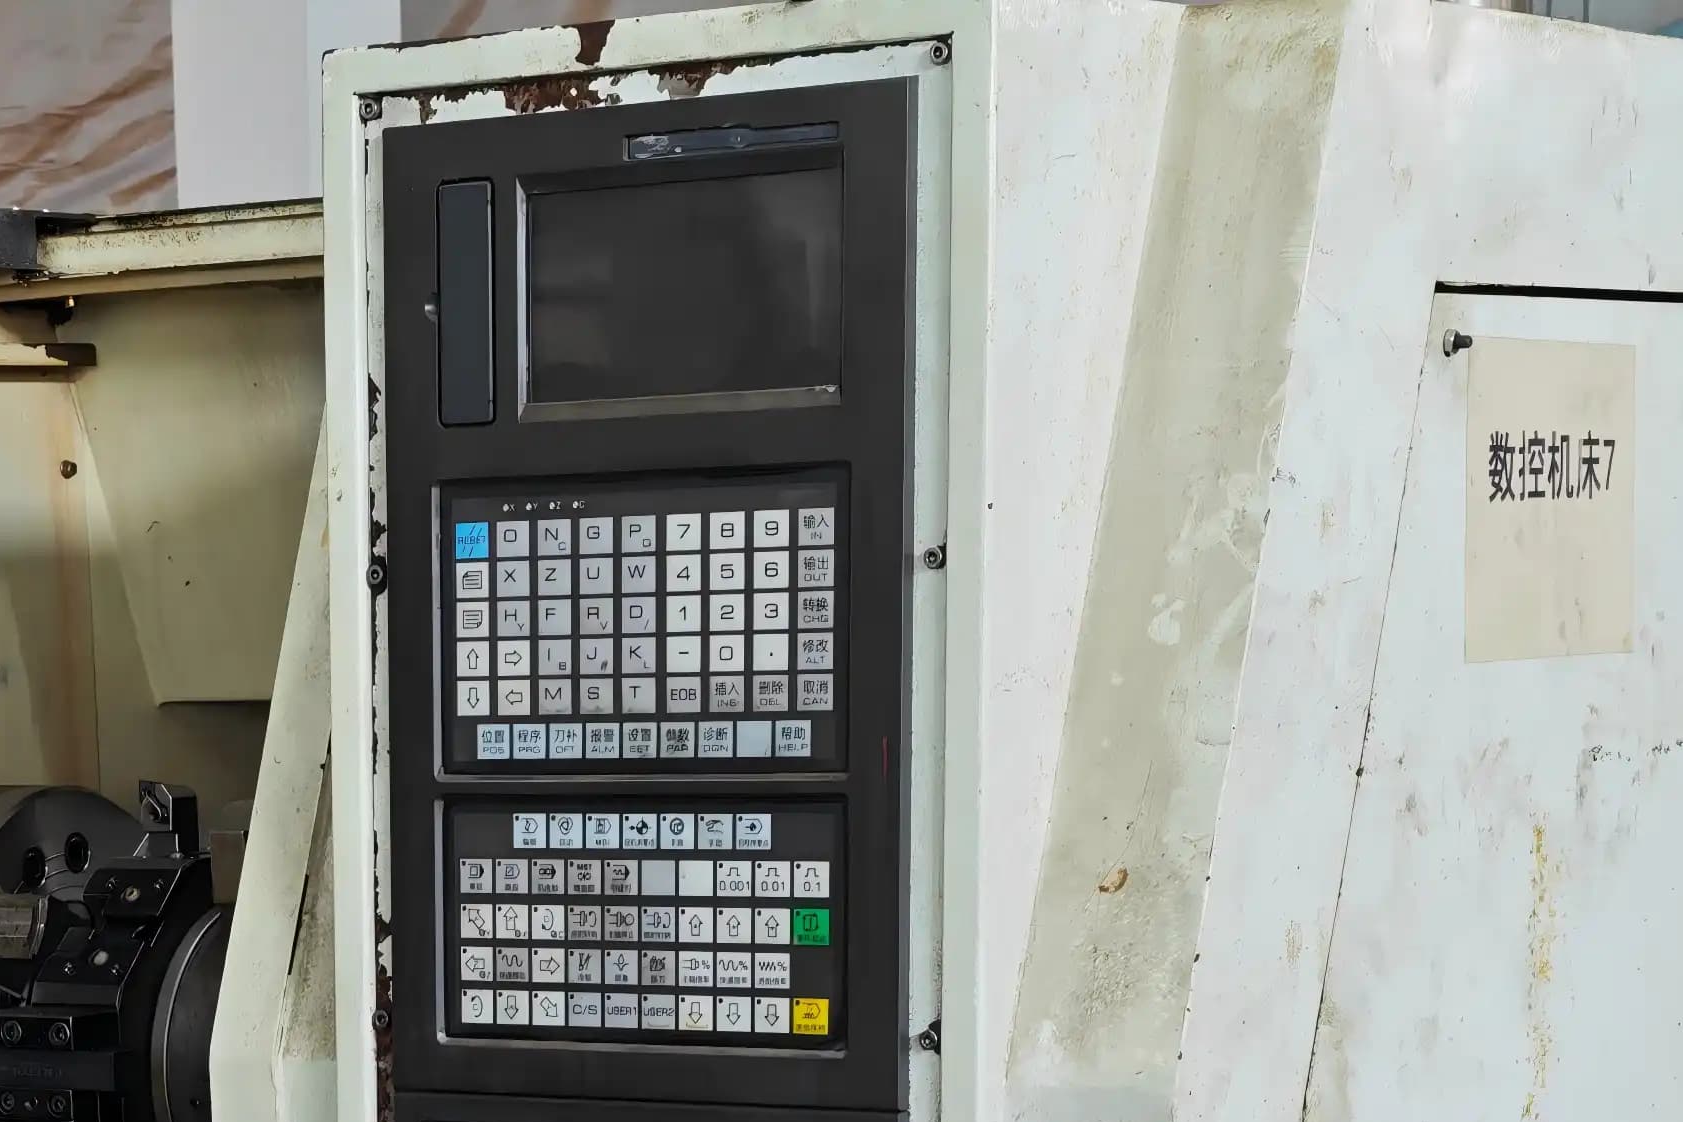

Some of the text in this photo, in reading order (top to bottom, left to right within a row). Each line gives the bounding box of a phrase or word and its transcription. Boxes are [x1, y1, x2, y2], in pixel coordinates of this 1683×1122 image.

[1488, 430, 1615, 503] 数控机床7
[545, 527, 558, 541] N
[587, 526, 600, 539] G
[630, 524, 641, 538] P
[677, 524, 690, 539] 7
[721, 522, 734, 538] 8
[765, 521, 779, 536] 9
[504, 569, 516, 582] X
[544, 568, 557, 581] Z
[587, 566, 600, 579] U
[628, 565, 646, 578] W
[677, 566, 690, 581] 4
[721, 564, 734, 578] 5
[764, 562, 778, 577] 6
[804, 573, 828, 582] OUT
[504, 608, 517, 622] H
[545, 608, 556, 621] F
[629, 605, 643, 619] D
[679, 606, 686, 621] 1
[721, 605, 734, 619] 2
[764, 603, 778, 618] 3
[586, 647, 597, 660] J
[629, 645, 642, 660] K
[719, 646, 733, 660] 0
[544, 687, 562, 700] M
[587, 686, 600, 700] S
[629, 686, 641, 699] T
[670, 688, 697, 701] EOB
[803, 680, 829, 695] 取消
[778, 744, 808, 752] HELP
[761, 881, 785, 892] 0.01
[803, 881, 821, 892] 0.1
[572, 1004, 597, 1016] C/S
